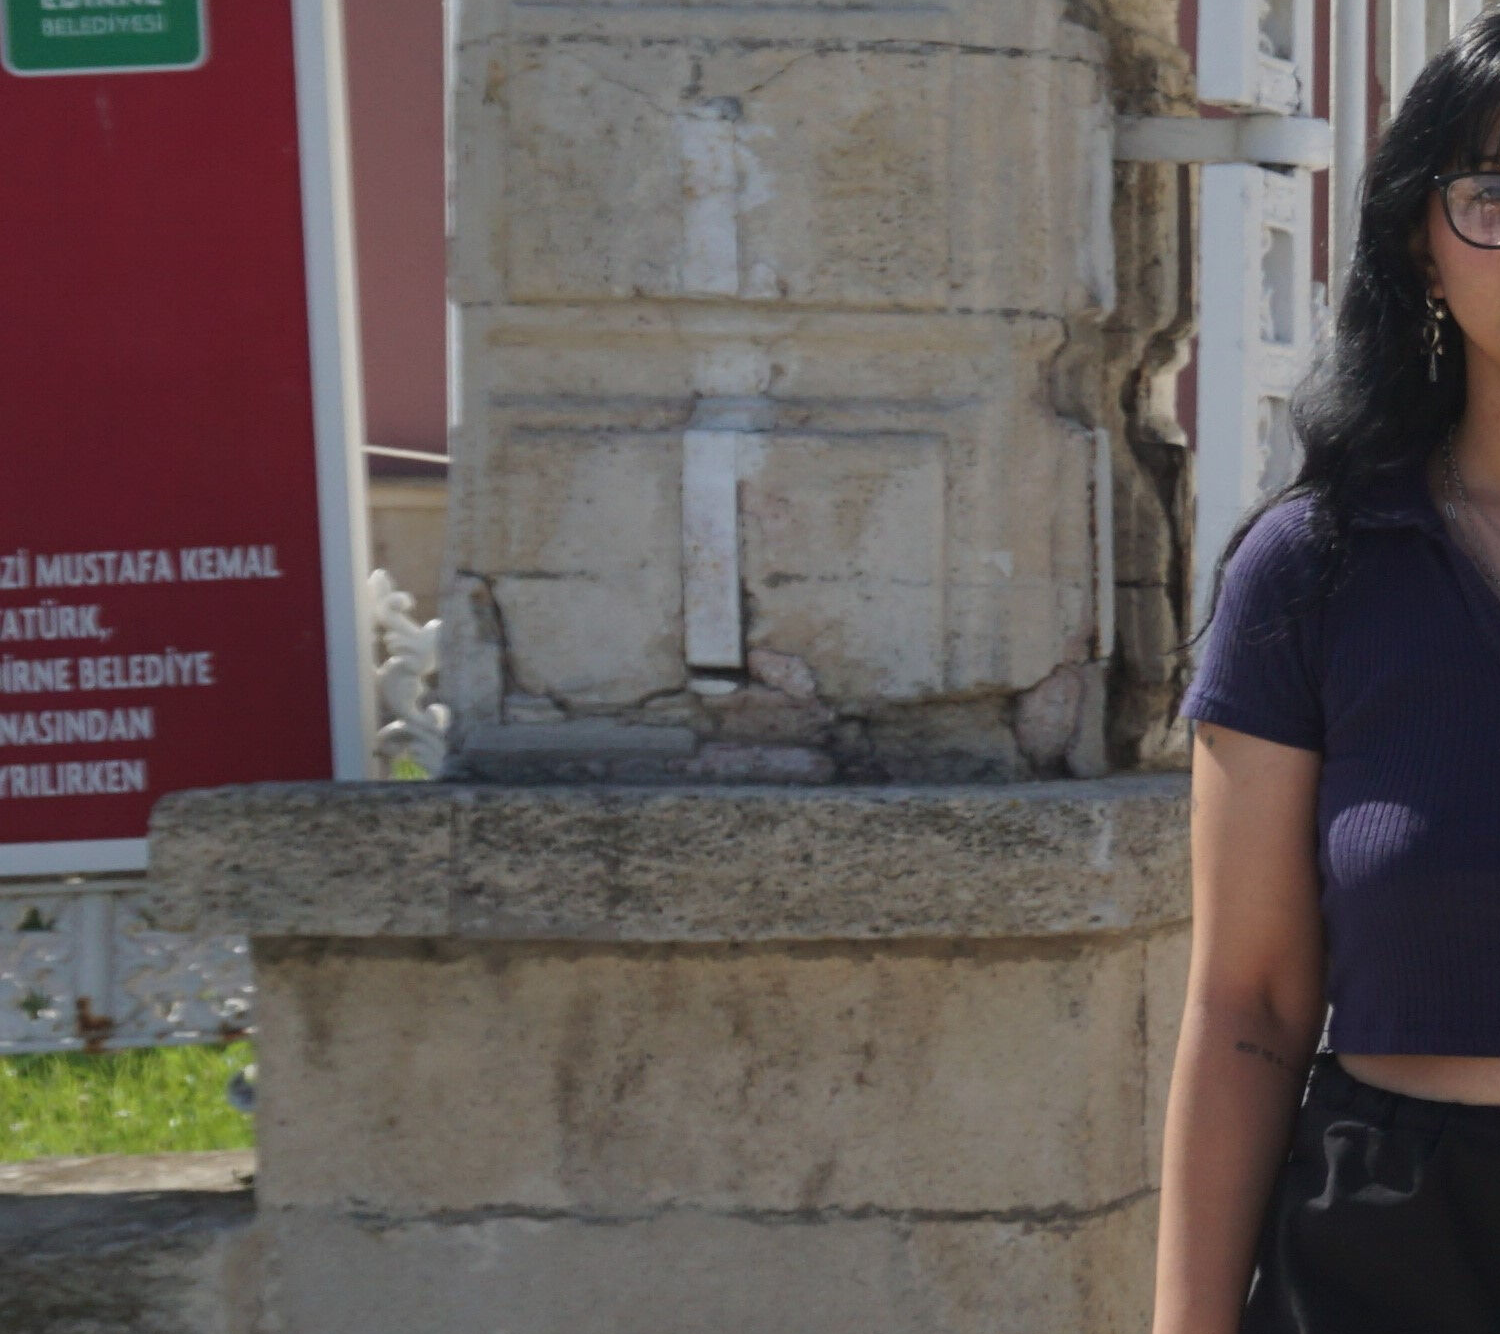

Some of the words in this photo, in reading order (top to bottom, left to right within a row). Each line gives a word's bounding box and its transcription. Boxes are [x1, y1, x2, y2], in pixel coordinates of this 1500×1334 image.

[35, 548, 176, 588] MUSTAFA
[179, 544, 282, 582] KEMAL
[0, 598, 114, 642] ATÜRK,
[0, 654, 73, 694] İRNE
[78, 646, 216, 691] BELEDİYE
